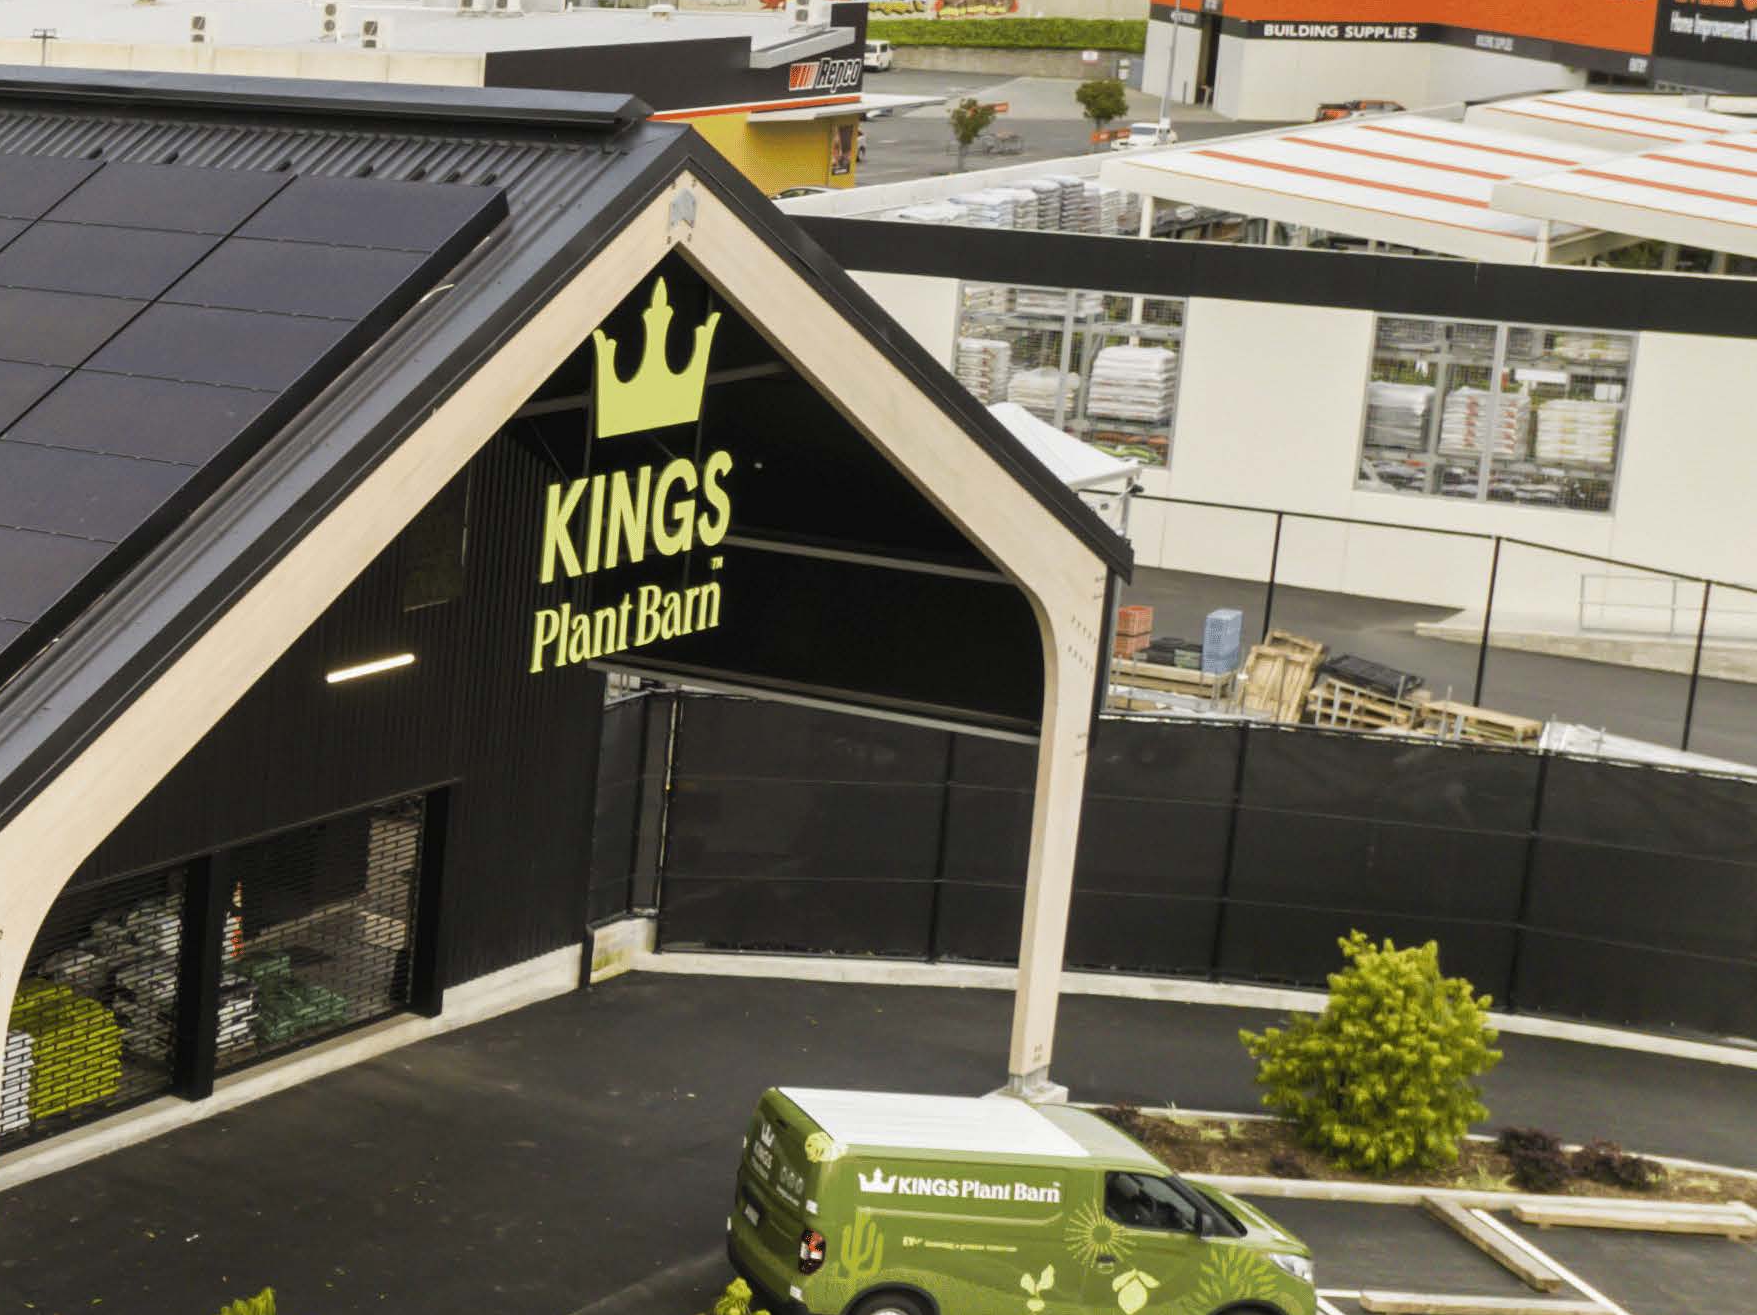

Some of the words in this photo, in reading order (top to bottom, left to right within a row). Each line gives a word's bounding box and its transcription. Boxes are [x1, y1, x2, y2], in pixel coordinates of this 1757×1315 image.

[1264, 24, 1338, 38] BUILDING
[1344, 26, 1418, 40] SUPPLIES
[815, 57, 862, 93] Repco
[540, 451, 733, 584] KINGS
[529, 587, 633, 674] Plant
[634, 581, 722, 648] Barn
[898, 1176, 960, 1198] KINGS
[961, 1180, 1011, 1201] Plant
[1013, 1183, 1061, 1203] Barn
